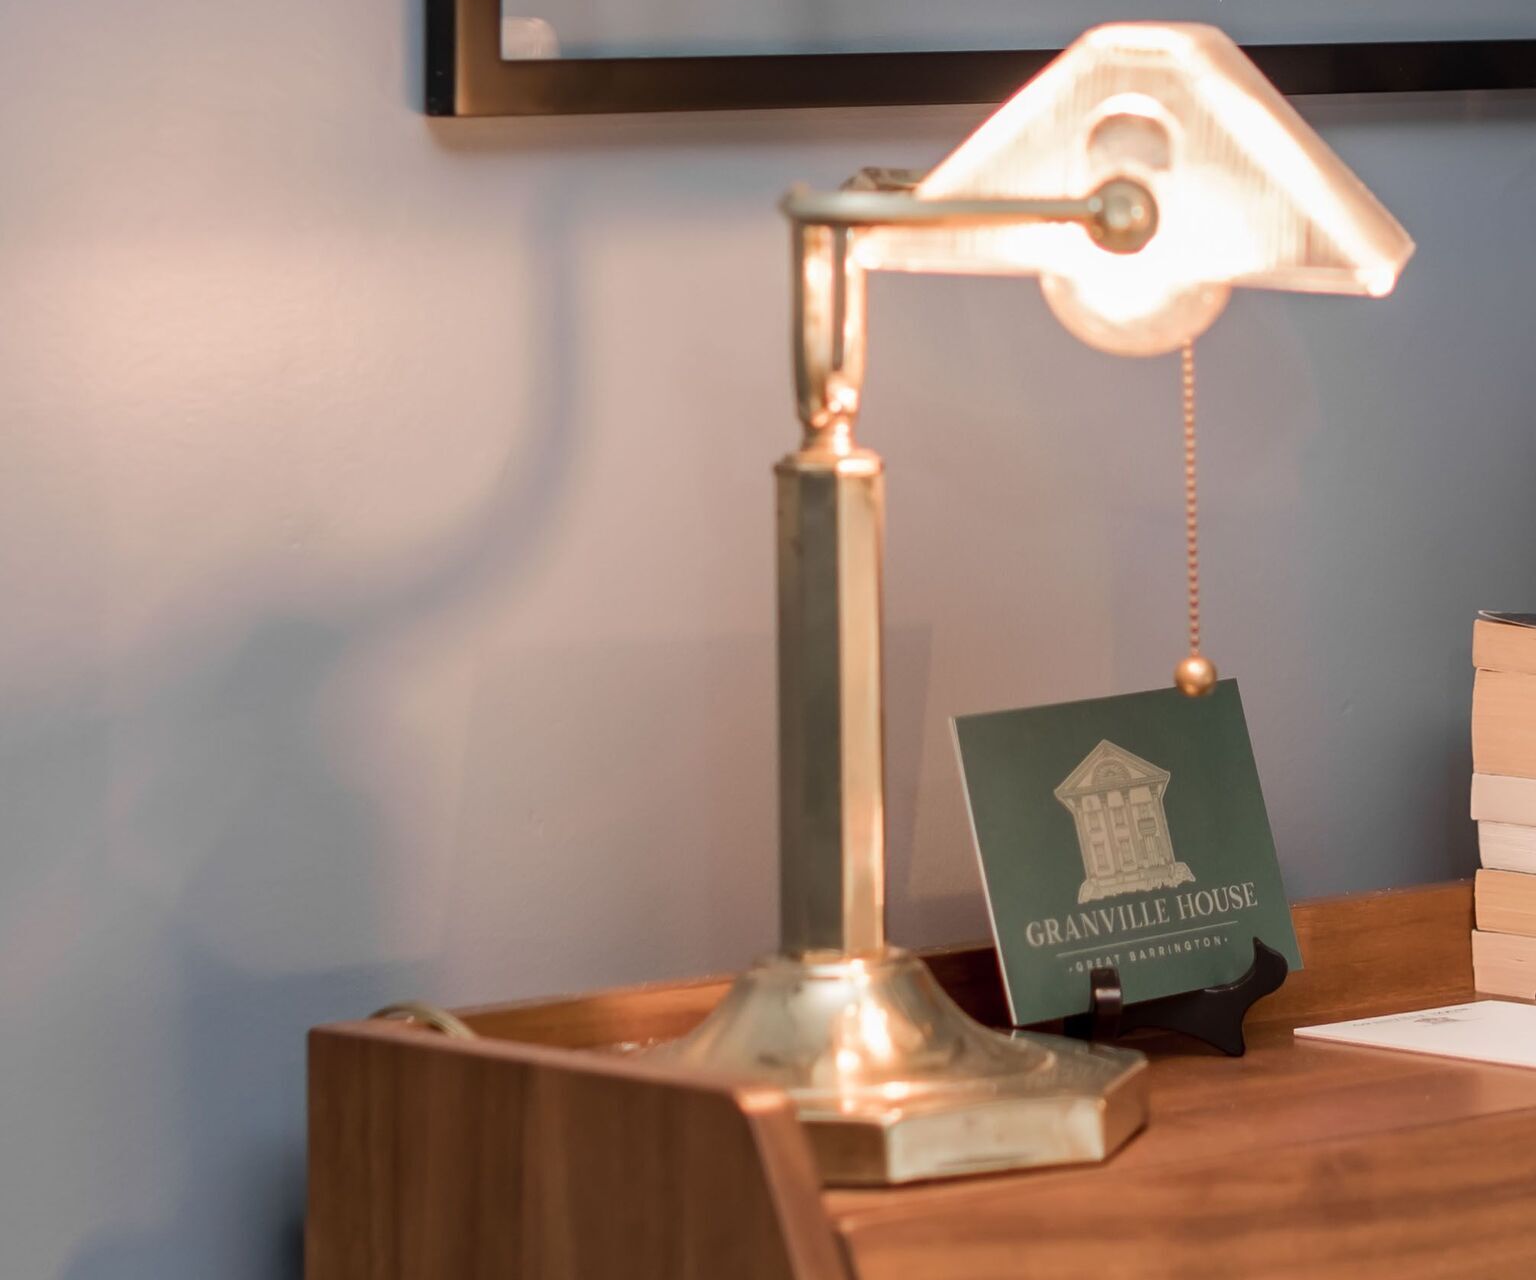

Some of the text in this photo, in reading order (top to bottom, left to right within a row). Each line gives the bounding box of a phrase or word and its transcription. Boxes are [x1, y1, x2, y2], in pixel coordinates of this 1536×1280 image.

[1025, 880, 1259, 948] GRANVILLE HOUSE
[1129, 935, 1222, 963] BARRINGTON
